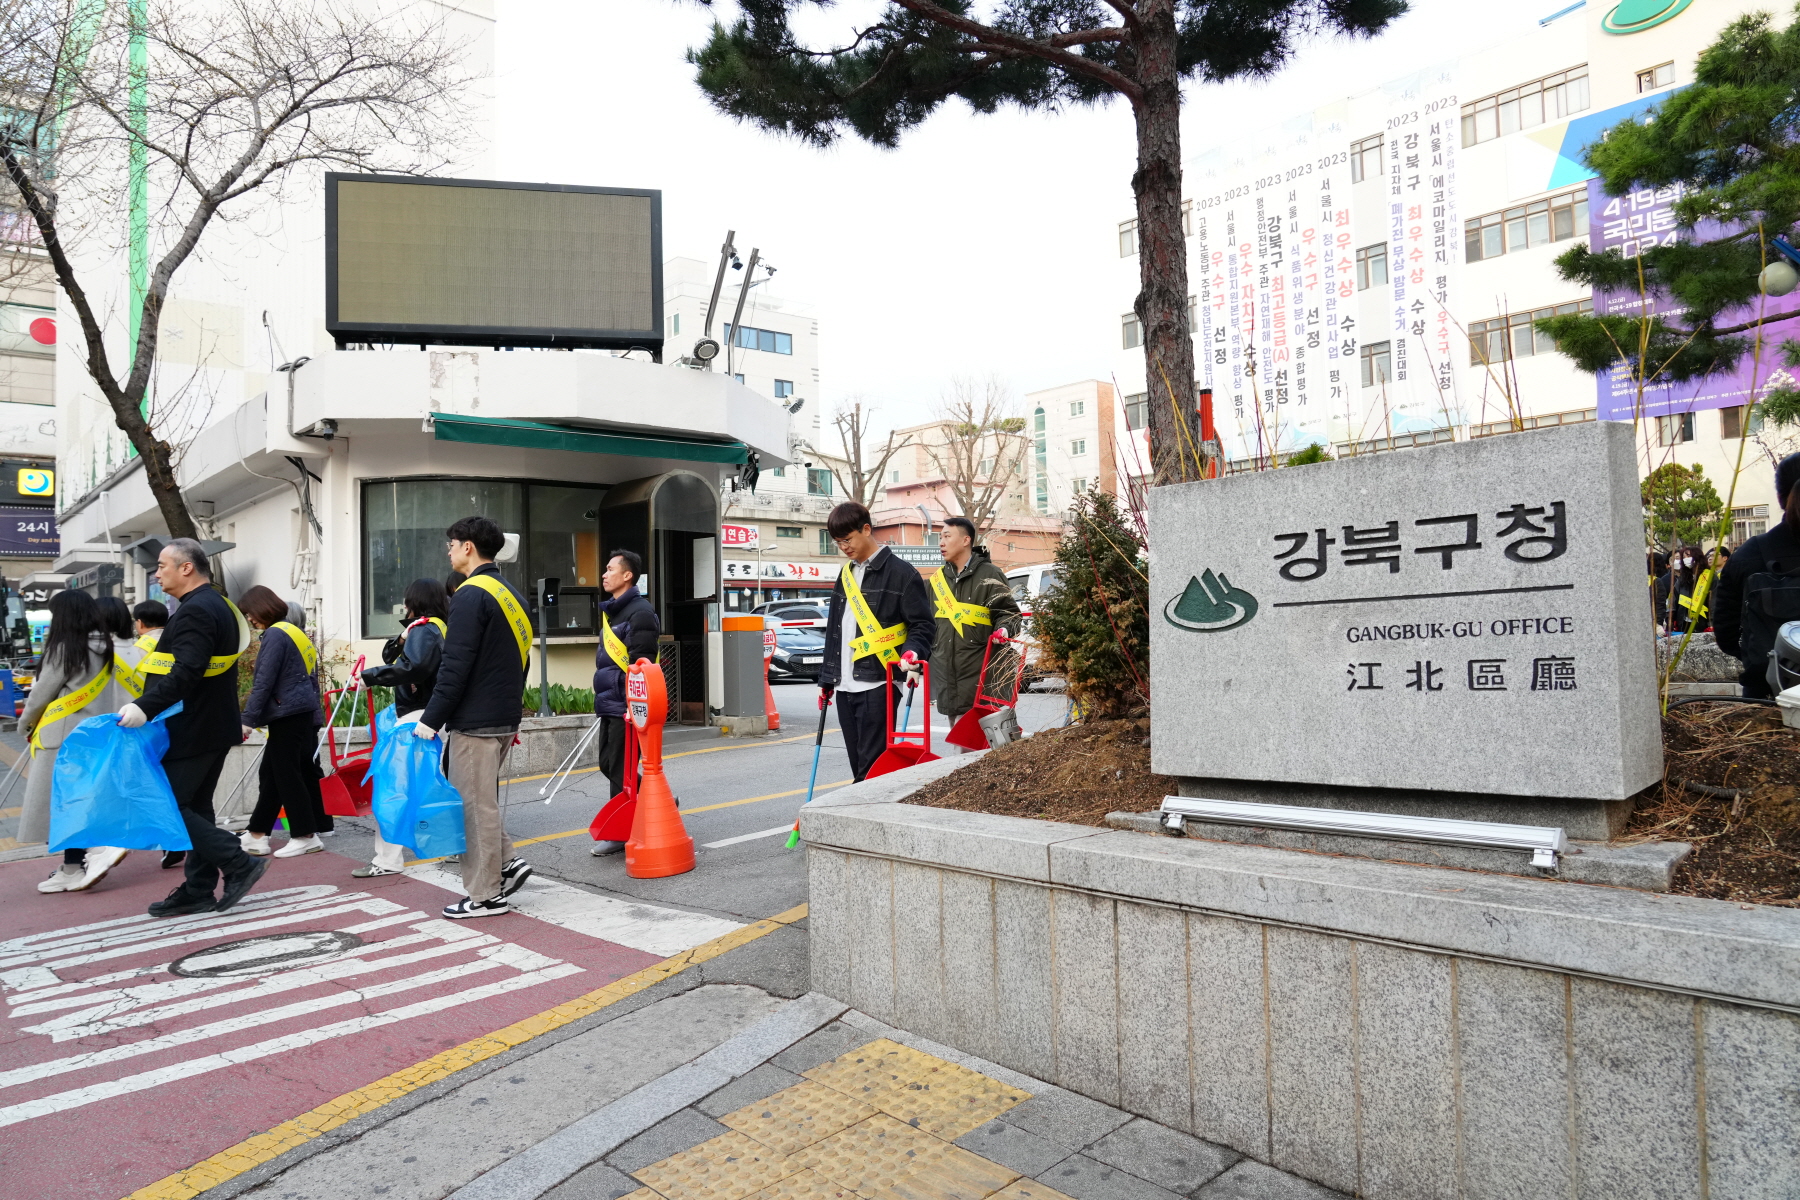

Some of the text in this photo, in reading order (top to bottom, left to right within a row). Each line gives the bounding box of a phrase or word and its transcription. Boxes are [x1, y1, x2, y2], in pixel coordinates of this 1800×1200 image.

[1387, 111, 1419, 130] 2023
[1425, 95, 1458, 115] 2023
[1318, 152, 1347, 169] 2023
[1390, 139, 1399, 160] 전국
[1429, 122, 1442, 167] 서울시
[1255, 174, 1282, 191] 2023
[1285, 163, 1313, 182] 2023
[1391, 164, 1401, 196] 지자체
[1197, 195, 1222, 212] 2023
[1224, 185, 1250, 202] 2023
[1226, 210, 1236, 247] 서울시
[1288, 189, 1298, 234] 서울시
[1267, 215, 1284, 269] 강북구
[1404, 133, 1426, 336] 강북구 최우수상 수상
[1393, 246, 1405, 271] 무상
[1228, 254, 1240, 328] 통합지원본부
[1302, 227, 1320, 349] 우수구 선정
[1320, 178, 1333, 223] 서울시
[1329, 370, 1341, 399] 평가
[1335, 209, 1357, 357] 최우수상 수상
[1394, 275, 1406, 301] 방문
[1436, 275, 1448, 303] 평가
[1199, 217, 1214, 391] 고용노동부 주관 청년도전지원사
[1211, 251, 1227, 365] 우수구 선정
[1239, 243, 1258, 378] 우수 자치구 수상
[1256, 197, 1275, 414] 행정안전부 주관 자연재해 안전도 평가
[1271, 275, 1290, 363] 최고등급(A)
[1437, 311, 1449, 354] 우수구
[1396, 338, 1407, 381] 경진대회
[1439, 362, 1451, 390] 선정
[1232, 365, 1242, 390] 향상
[1274, 369, 1289, 405] 선정
[1234, 394, 1244, 419] 평가
[16, 521, 48, 534] 24시
[1273, 500, 1568, 582] 강북구청
[1346, 617, 1574, 643] GANGBUK-GU OFFICE
[629, 680, 648, 698] 주차금지
[1346, 655, 1578, 693] 江北區廳
[631, 704, 648, 718] 강북구청
